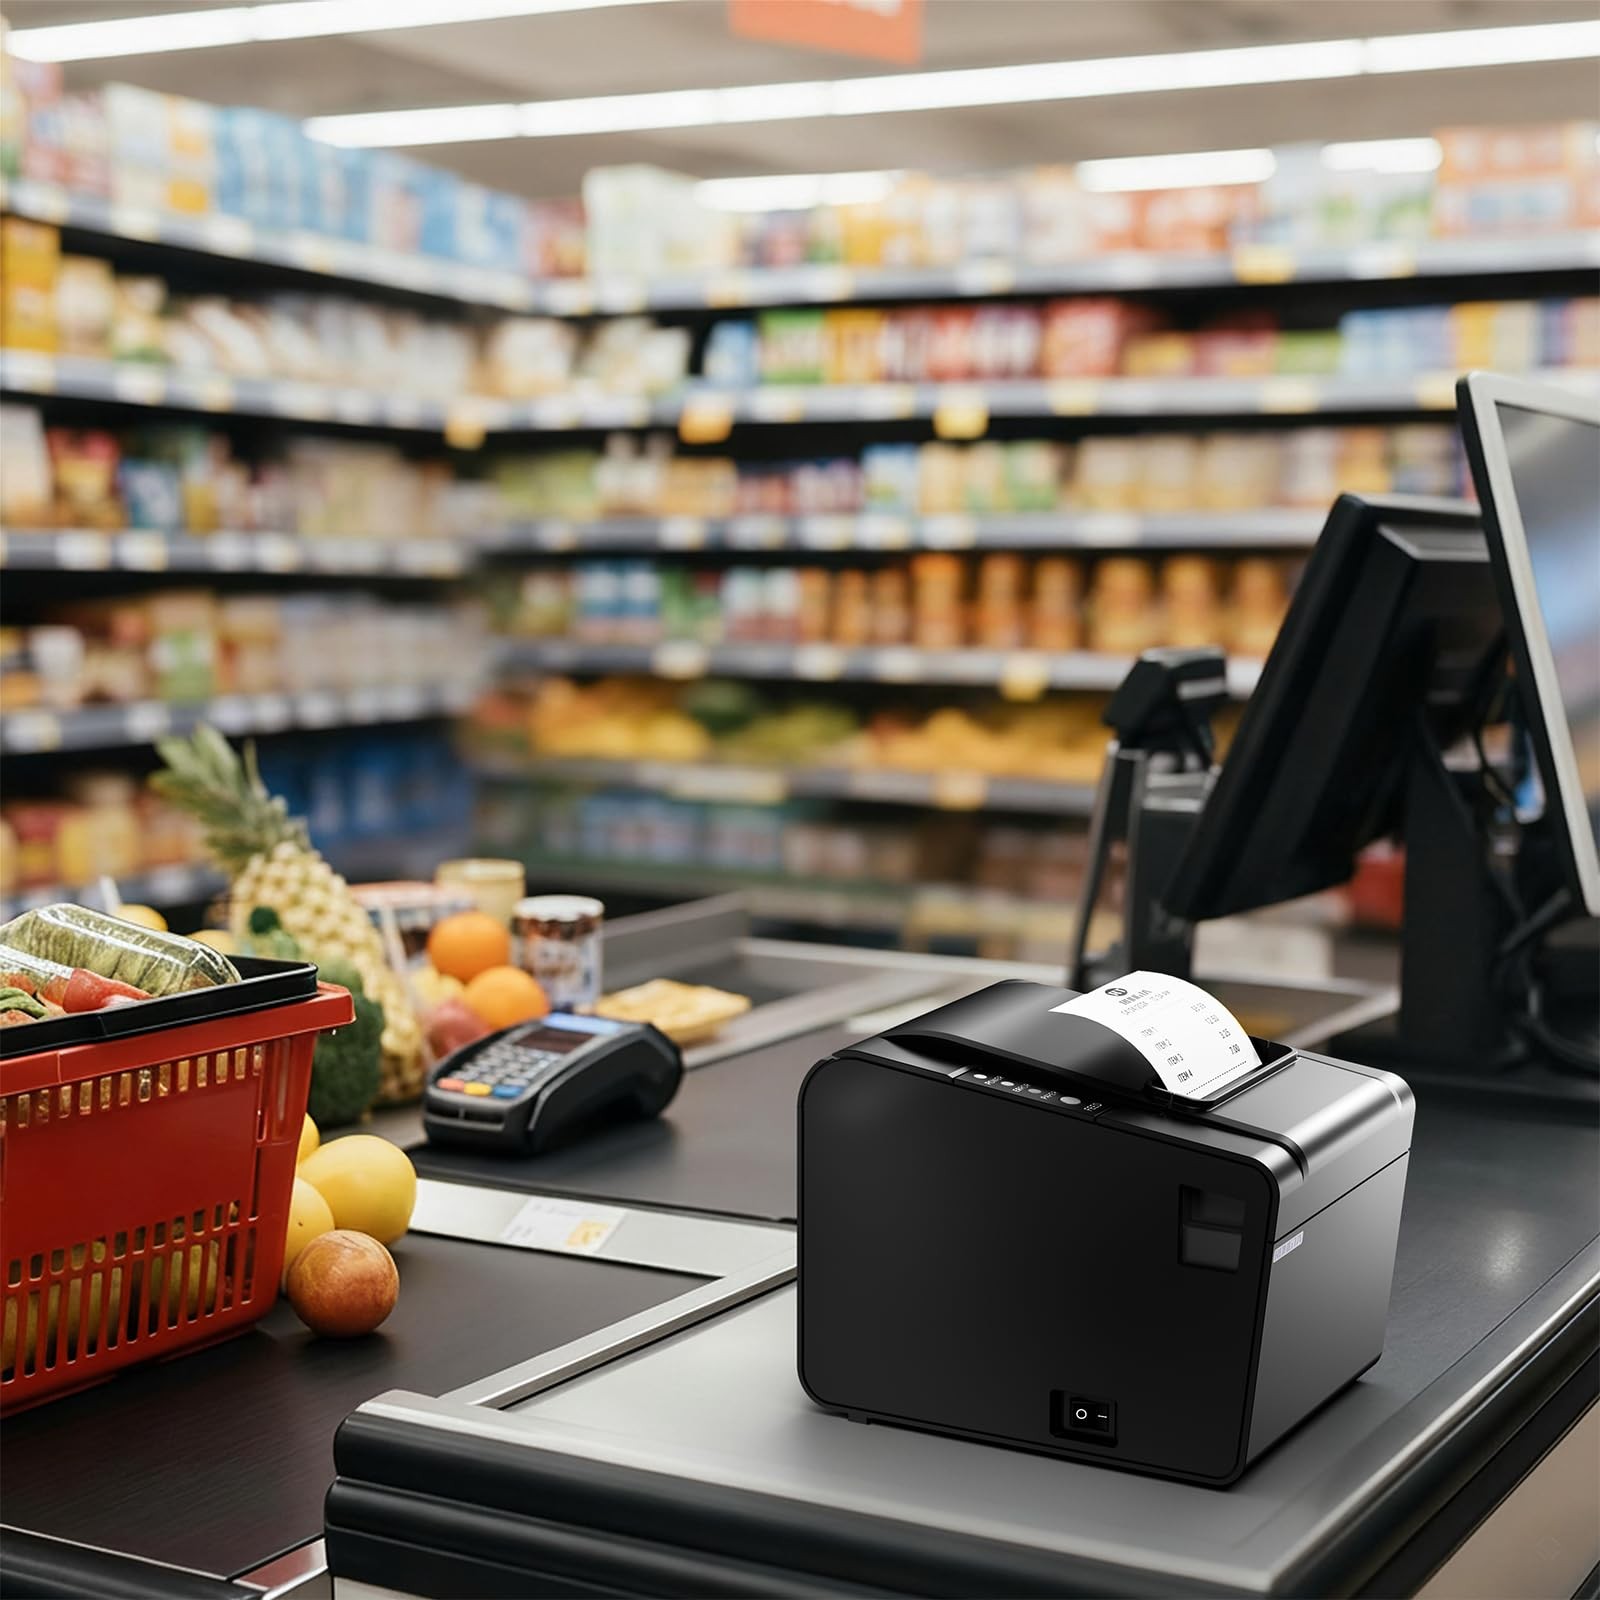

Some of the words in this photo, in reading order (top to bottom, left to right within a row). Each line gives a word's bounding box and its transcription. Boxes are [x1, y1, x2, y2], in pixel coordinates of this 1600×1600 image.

[1155, 1041, 1166, 1051] ITEM
[1167, 1055, 1179, 1066] ITEM
[1177, 1071, 1190, 1082] ITEM
